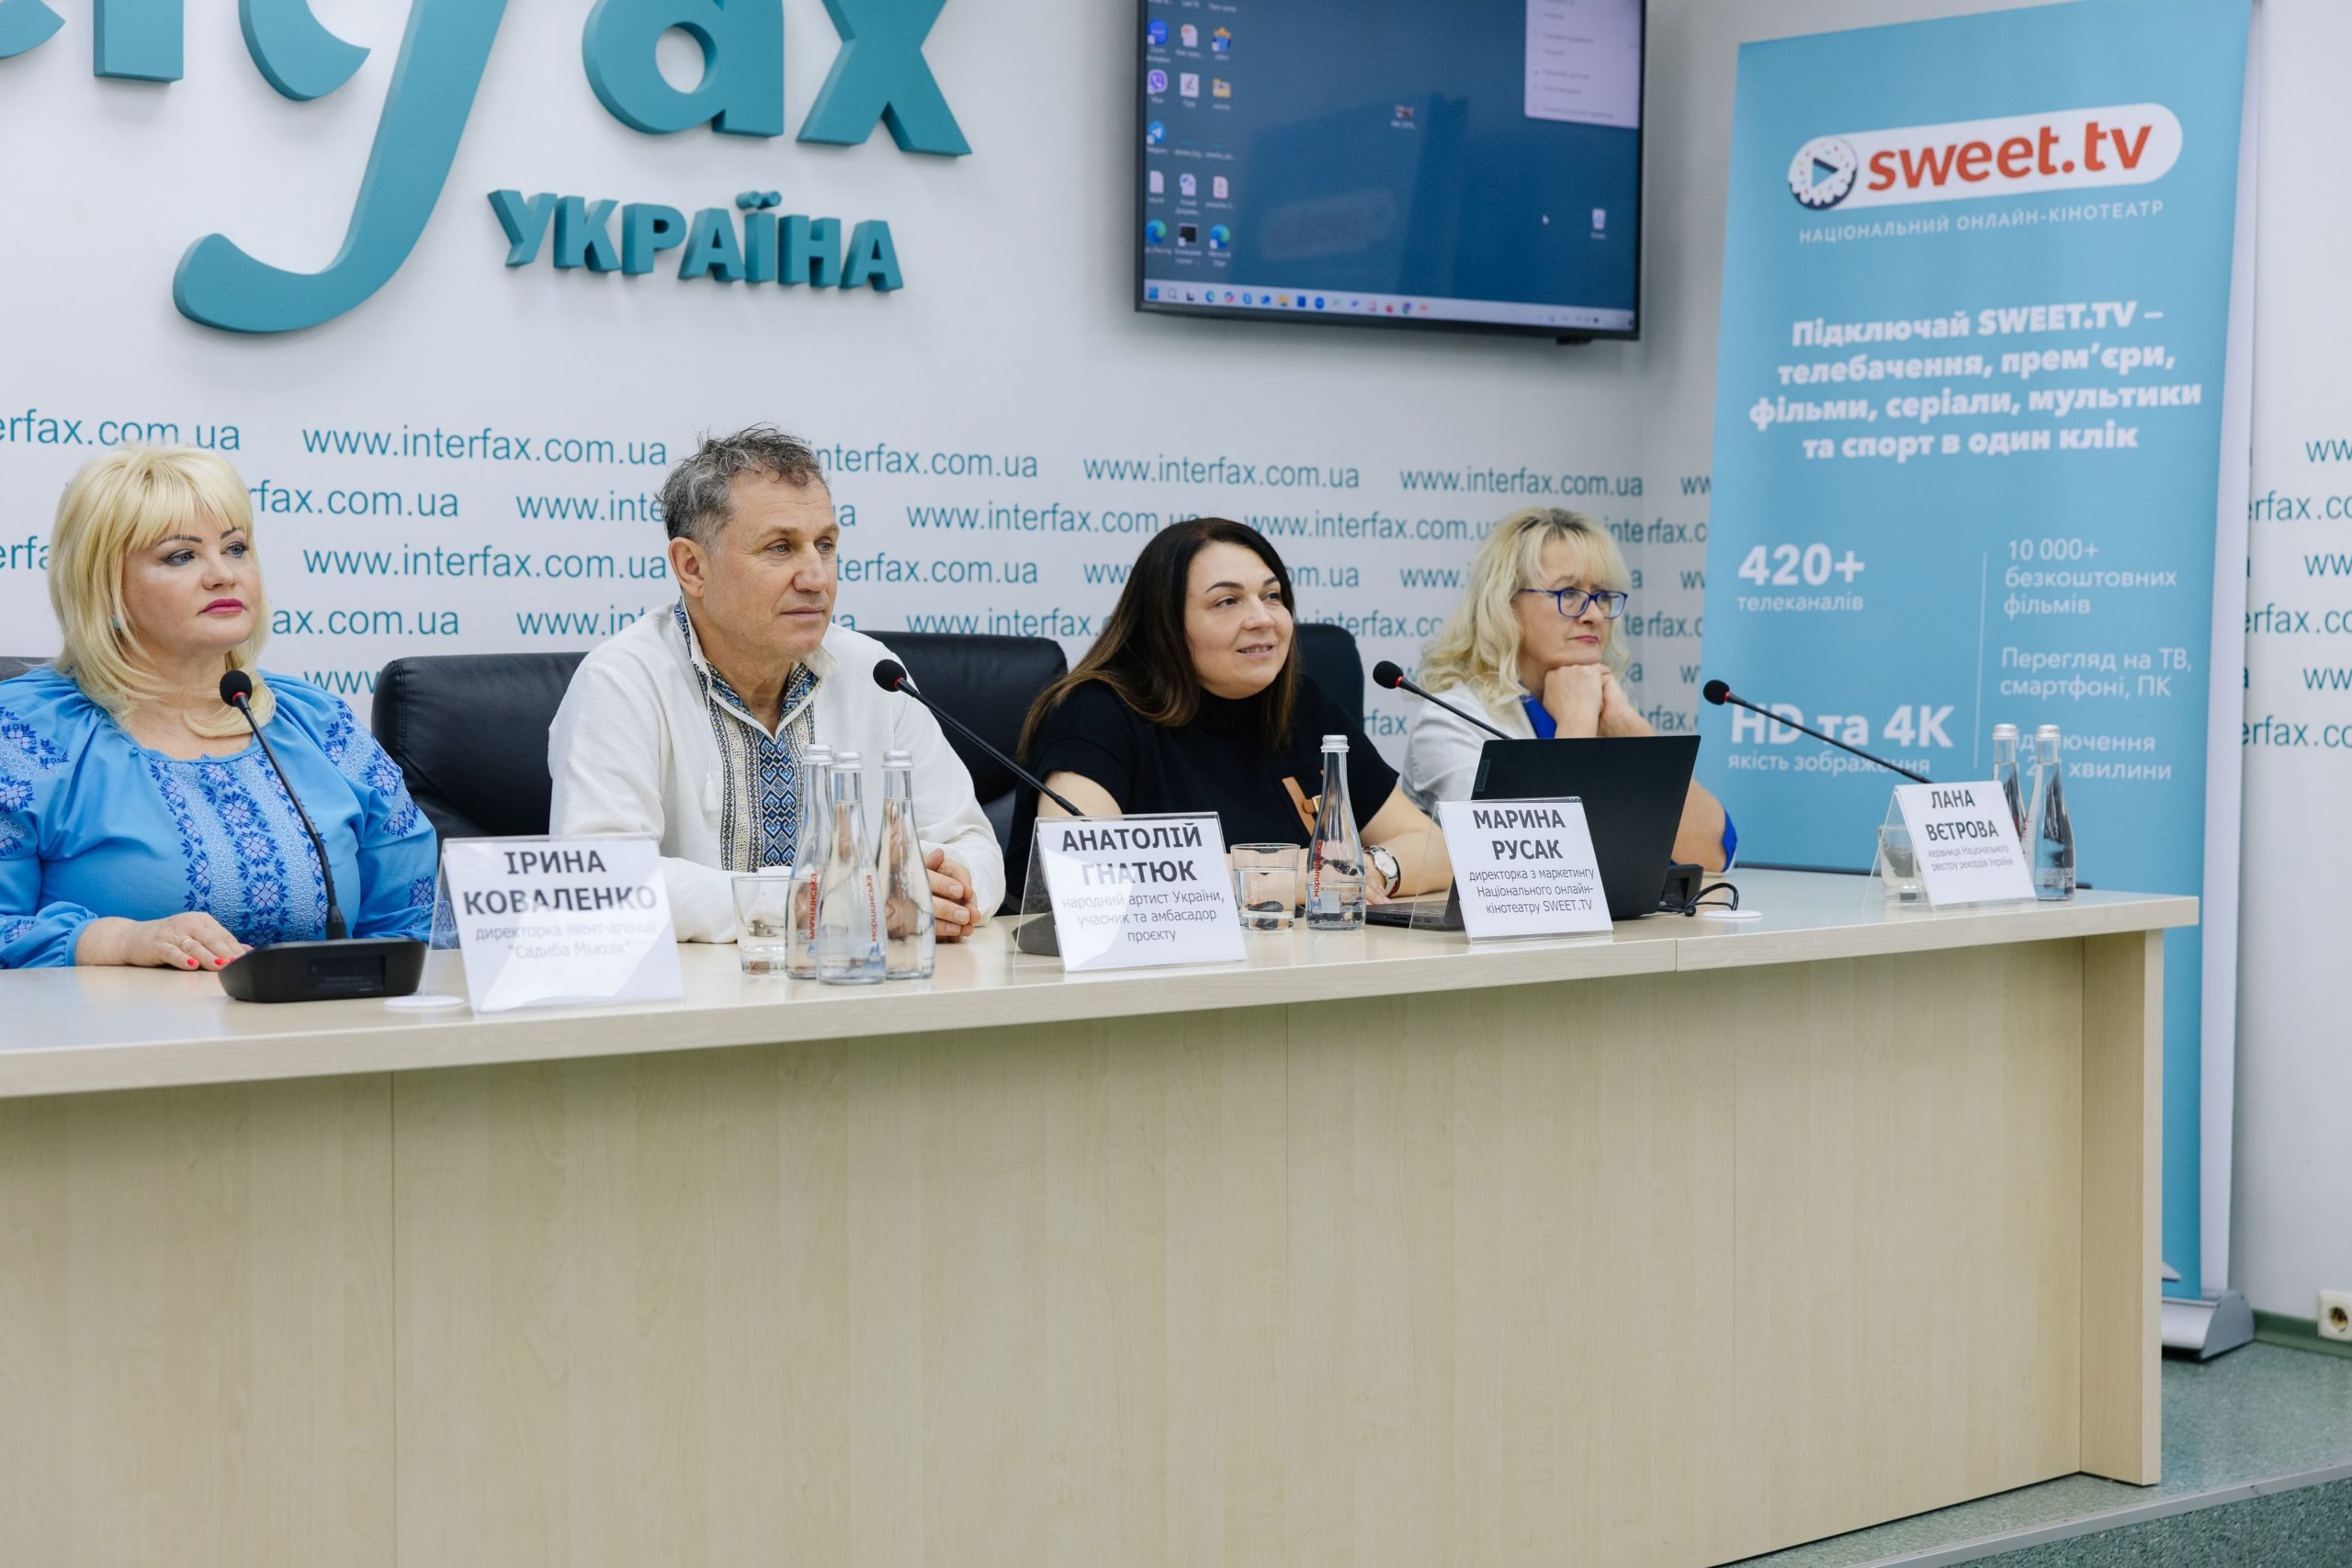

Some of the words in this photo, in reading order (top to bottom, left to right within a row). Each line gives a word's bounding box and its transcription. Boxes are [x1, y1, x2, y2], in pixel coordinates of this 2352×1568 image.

[1867, 121, 2152, 192] sweet.tv
[1799, 214, 1950, 244] НАЦІОНАЛЬНИЙ
[1957, 199, 2165, 232] ОНЛАЙН-КІНОТЕАТР
[487, 188, 904, 292] УКРАЇНА
[1792, 310, 1970, 347] Підключай
[1977, 301, 2138, 335] SWEET.TV
[1778, 355, 1993, 385] телебачення,
[1749, 397, 1878, 431] фільми,
[1885, 389, 2020, 423] серіали,
[2029, 384, 2202, 417] мультики
[303, 427, 667, 465] www.interfax.com.ua
[1803, 438, 1835, 460] та
[1842, 435, 1934, 464] спорт
[1941, 435, 1961, 454] в
[1968, 432, 2051, 457] один
[2059, 420, 2139, 450] клік
[1084, 456, 1360, 489] www.interfax.com.ua
[1399, 467, 1643, 497] www.interfax.com.ua
[303, 544, 667, 579] www.interfax.com.ua
[2008, 539, 2034, 560] 10
[2041, 538, 2099, 560] 000+
[1738, 544, 1865, 585] 420+
[2005, 565, 2177, 589] безкоштовних
[1736, 592, 1864, 612] телеканалів
[2003, 593, 2091, 618] фільмів
[2001, 648, 2117, 674] Перегляд
[2123, 652, 2153, 670] на
[2158, 649, 2193, 672] ТВ,
[1999, 676, 2131, 701] смартфоні,
[2137, 677, 2172, 697] ПК
[1731, 704, 1804, 744] HD
[1816, 713, 1870, 747] та
[1728, 750, 1789, 771] якість
[2068, 761, 2172, 780] хвилини
[1931, 789, 1975, 809] ЛАНА
[1473, 809, 1566, 829] МАРИНА
[1925, 819, 1999, 841] ВЄТРОВА
[1062, 822, 1203, 852] АНАТОЛІЙ
[504, 850, 606, 874] ІРИНА
[1492, 840, 1564, 860] РУСАК
[1081, 860, 1198, 886] ГНАТЮК
[1470, 869, 1528, 882] директорка
[1531, 870, 1537, 878] з
[1539, 867, 1594, 880] маркетингу
[463, 886, 657, 915] КОВАЛЕНКО
[1062, 894, 1125, 911] народний
[1129, 894, 1169, 906] артист
[1173, 890, 1225, 905] України,
[1477, 886, 1553, 898] Національного
[1555, 883, 1594, 895] онлайн-
[1077, 913, 1129, 929] учасник
[1133, 914, 1148, 924] та
[1151, 908, 1217, 923] амбасадор
[1487, 899, 1541, 915] кінотеатру
[1544, 899, 1593, 911] SWEET.TV
[1127, 929, 1176, 943] проєкту
